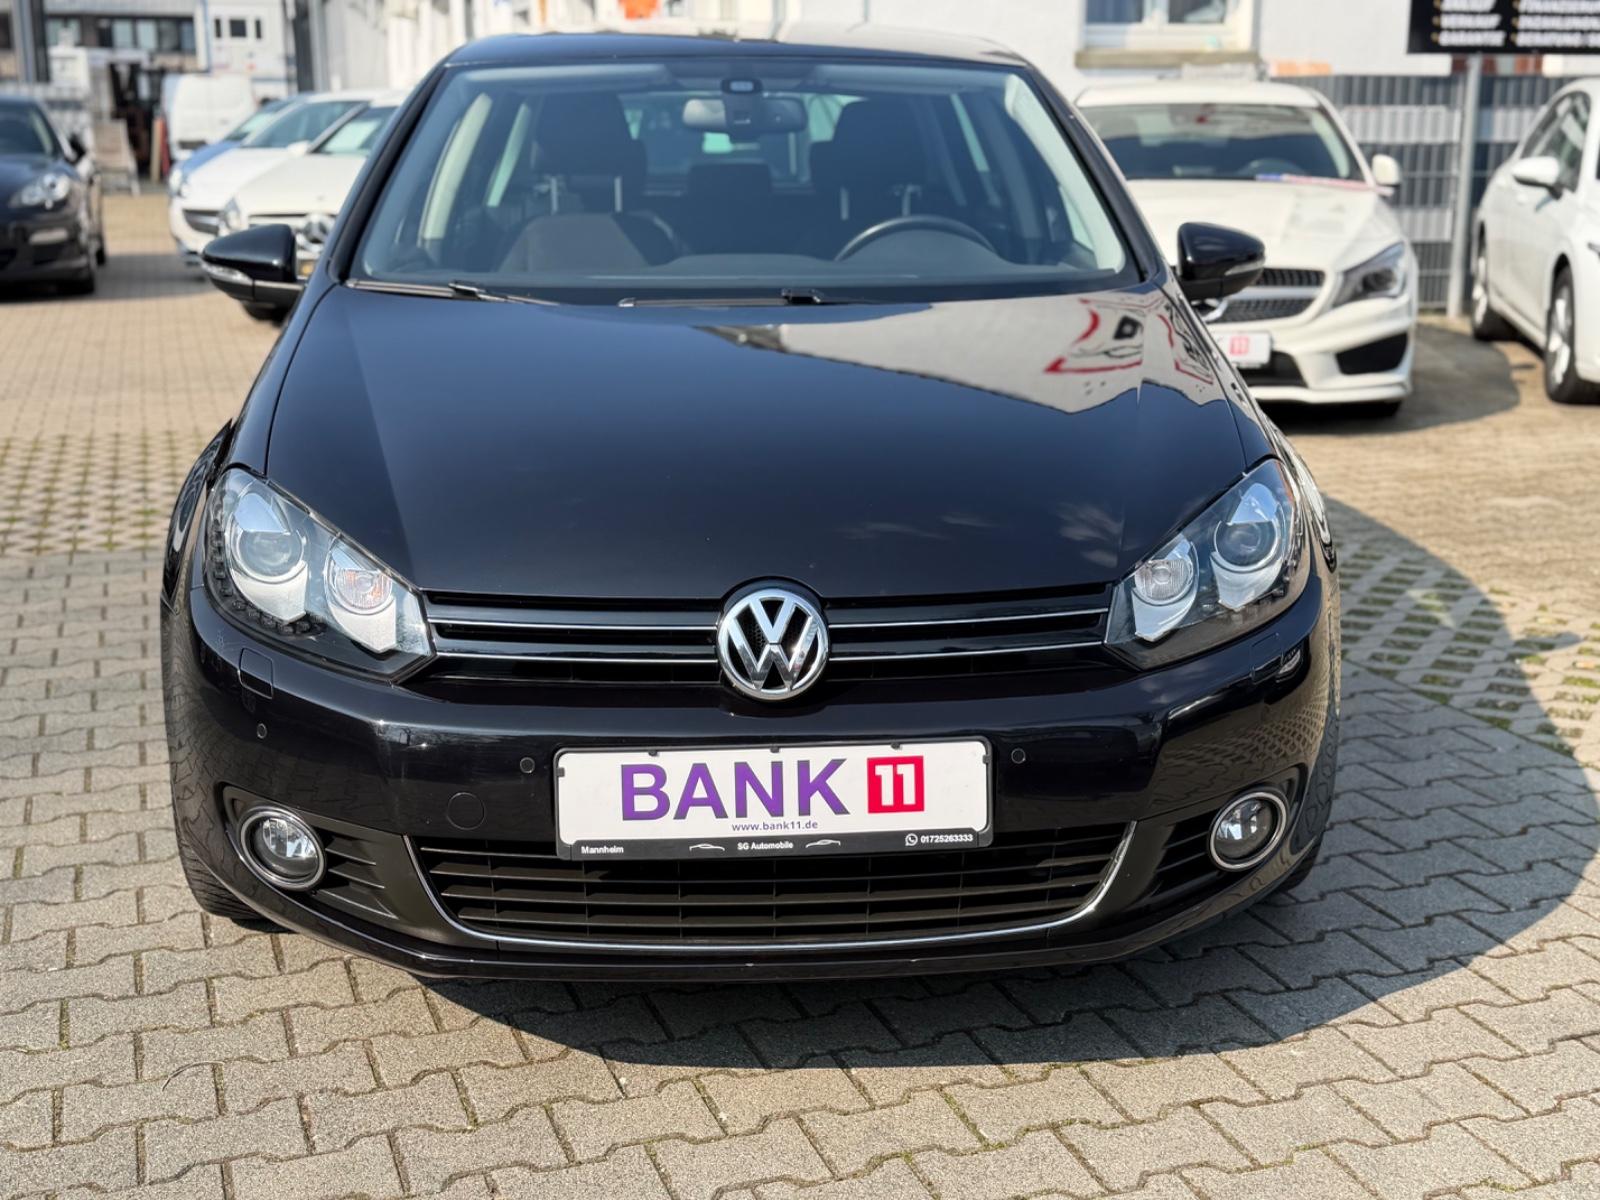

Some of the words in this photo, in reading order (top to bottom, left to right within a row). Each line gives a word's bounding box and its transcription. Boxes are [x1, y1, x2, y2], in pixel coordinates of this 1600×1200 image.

[621, 758, 850, 821] BANK
[874, 762, 917, 807] 11
[731, 820, 819, 831] www.bank11.de
[920, 834, 973, 844] 01725263333
[581, 845, 624, 855] Mannheim
[737, 841, 749, 851] SG
[750, 841, 794, 850] Automobile
